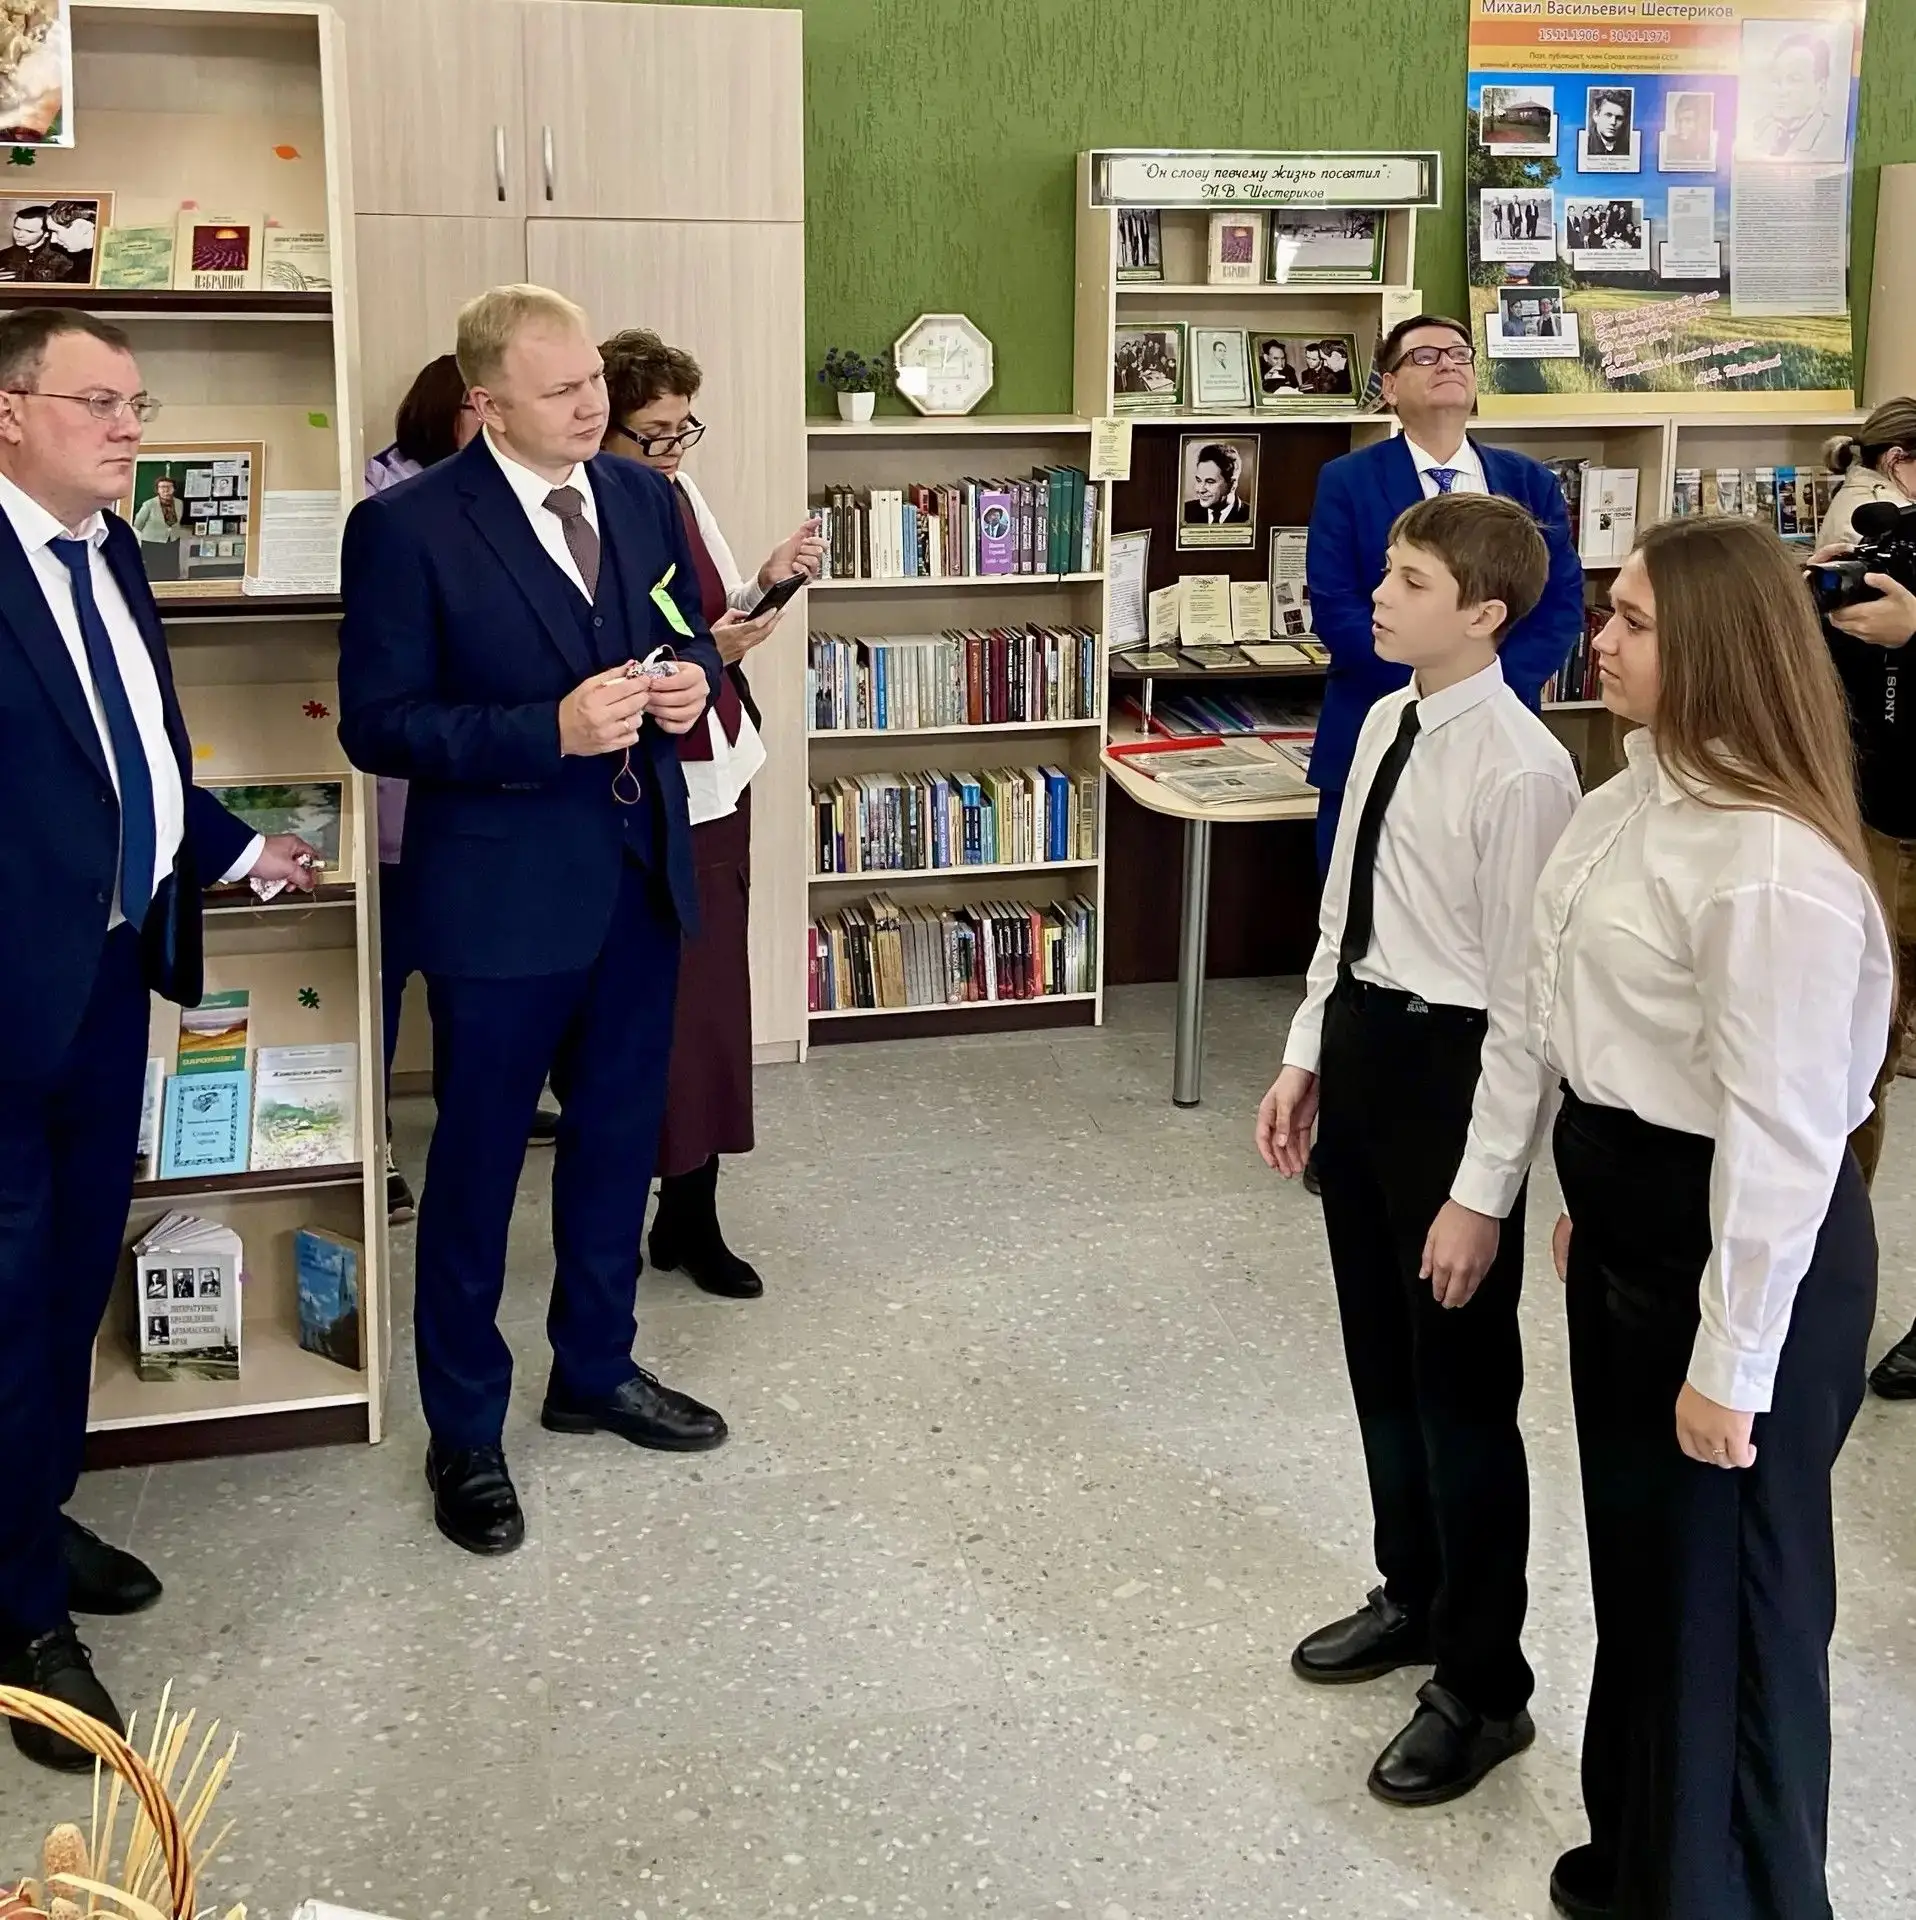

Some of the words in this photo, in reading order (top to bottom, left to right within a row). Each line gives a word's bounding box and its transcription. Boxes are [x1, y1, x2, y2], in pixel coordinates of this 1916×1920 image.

[1481, 1, 1541, 15] Михаил
[1547, 1, 1636, 16] Васильевич
[1641, 2, 1733, 20] Шестериков
[1538, 28, 1599, 42] 15.11.1906
[1609, 28, 1671, 43] 30.11.1974
[1171, 169, 1210, 181] слову
[1214, 168, 1268, 182] певчему
[1271, 165, 1316, 183] жизнь
[1243, 183, 1325, 201] Шестериков
[194, 275, 245, 290] ИЗБРАННОЕ
[1884, 676, 1897, 724] SONY
